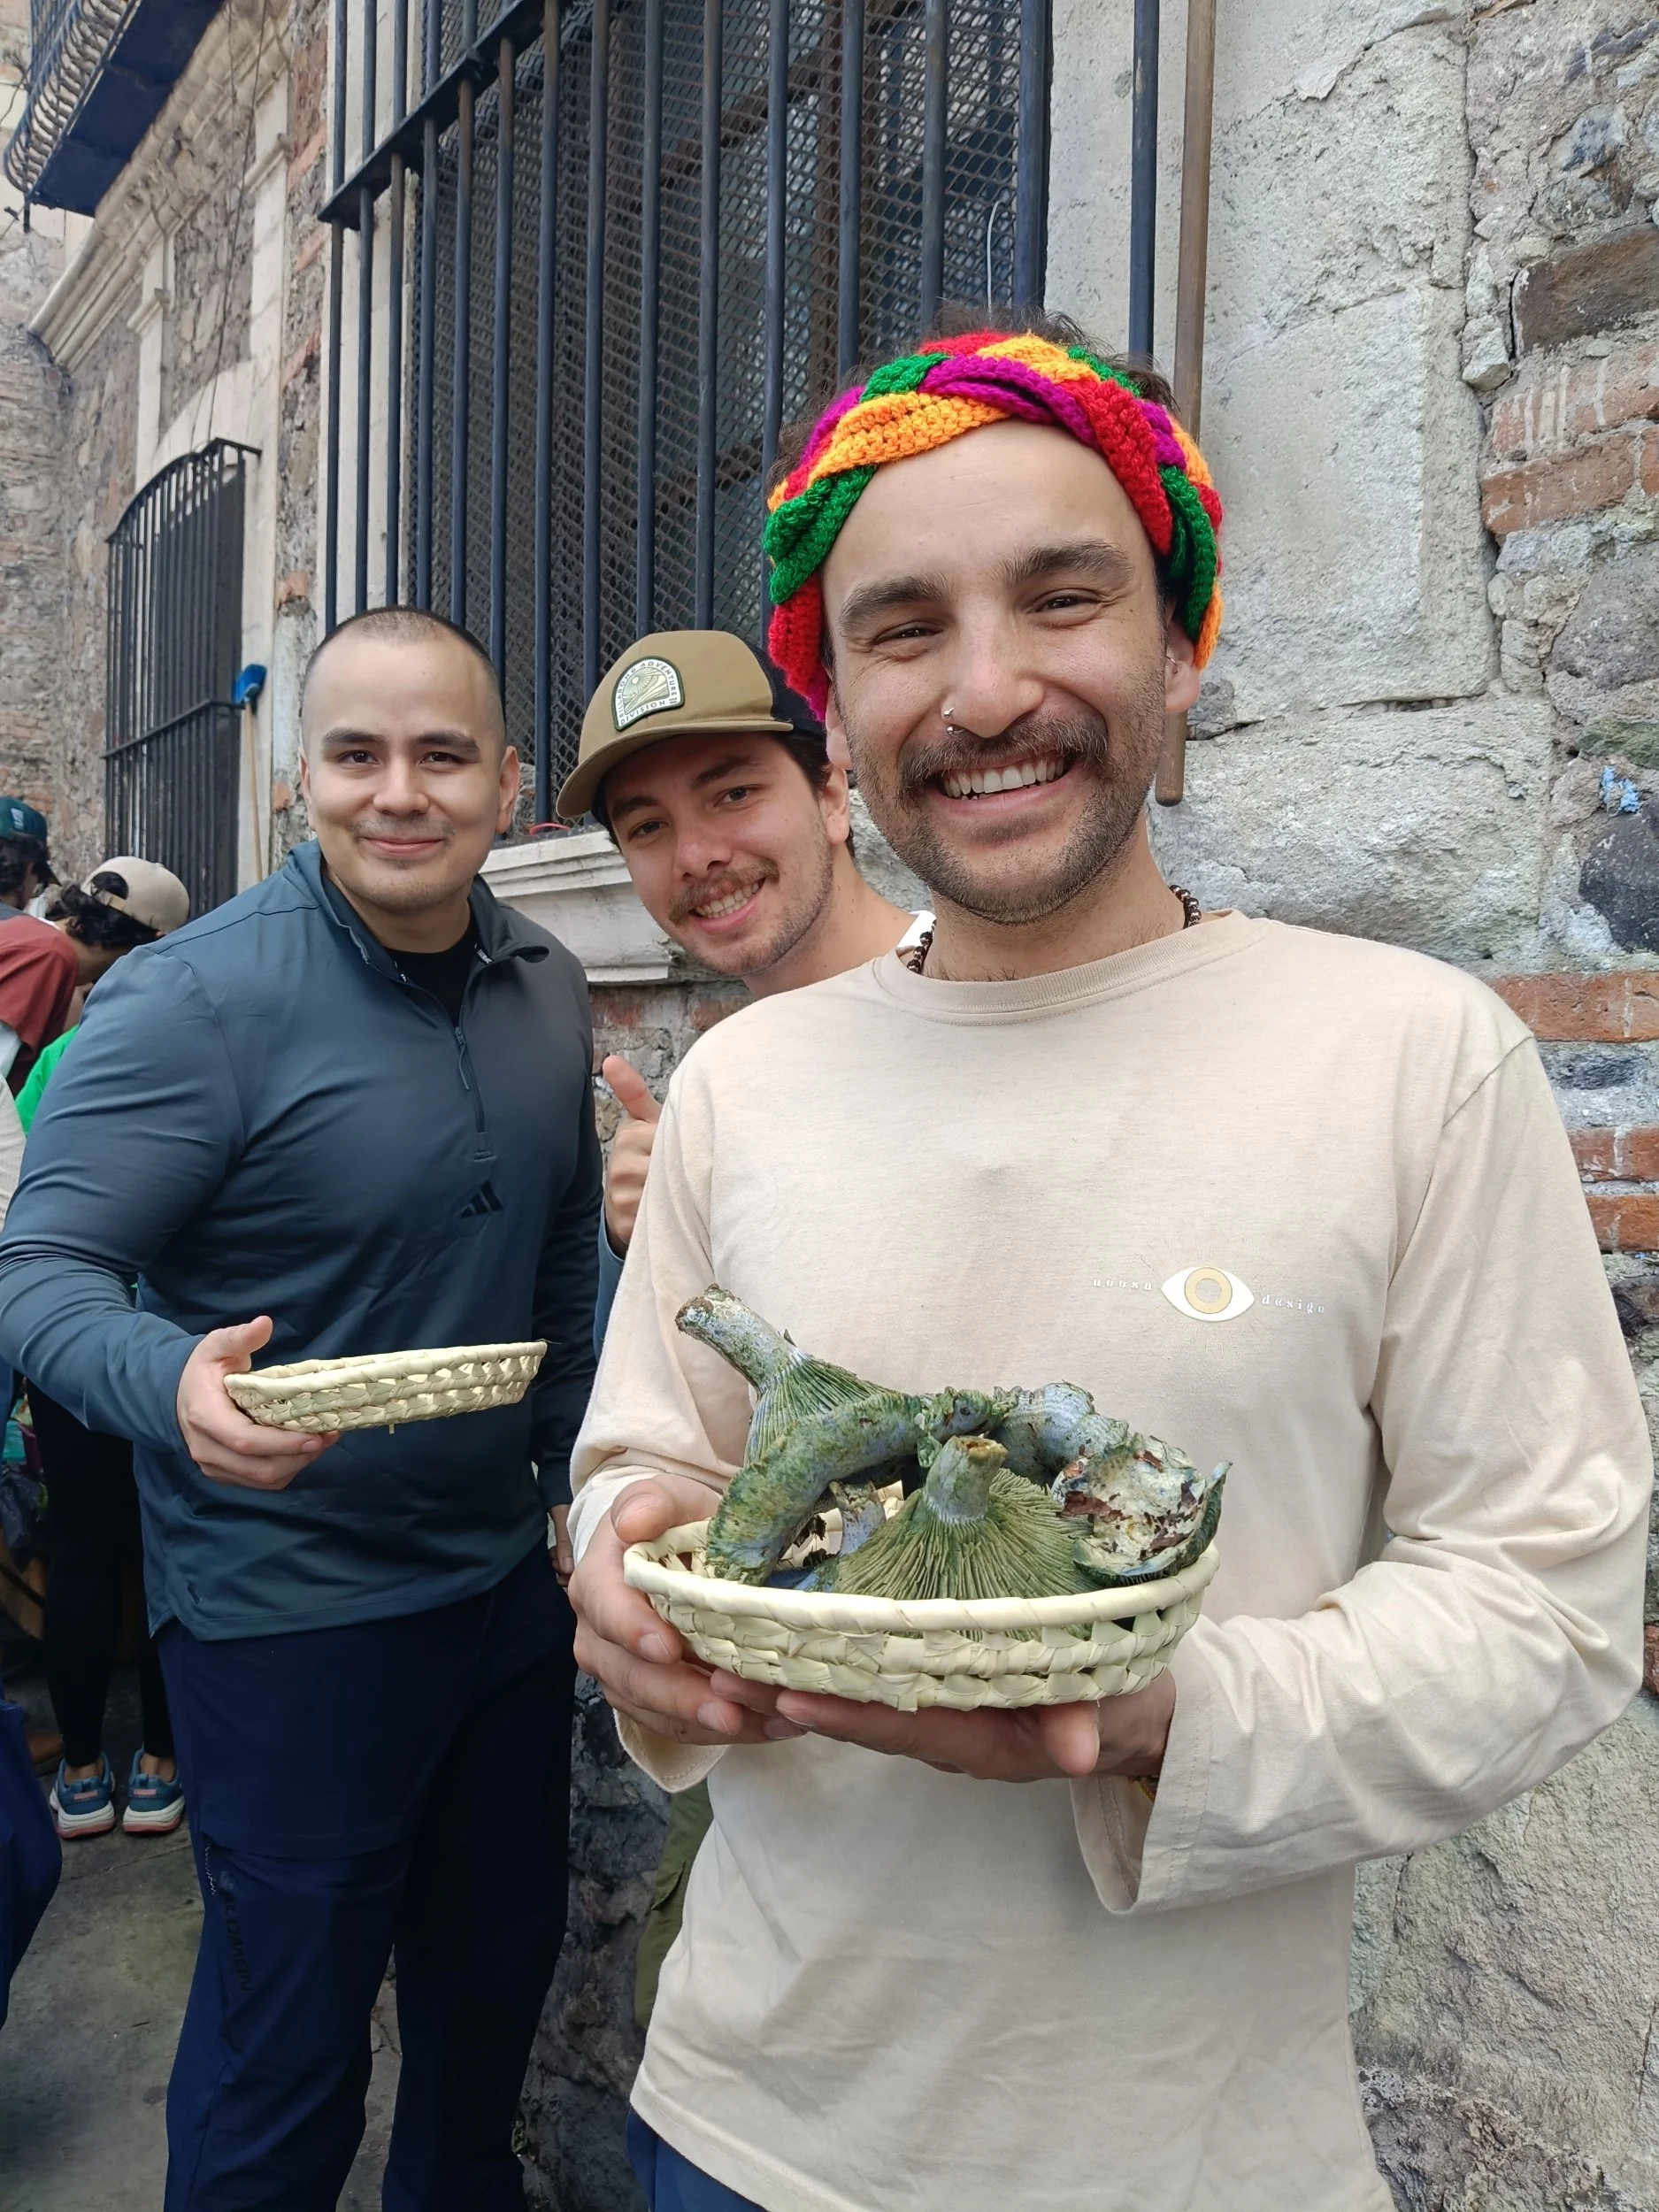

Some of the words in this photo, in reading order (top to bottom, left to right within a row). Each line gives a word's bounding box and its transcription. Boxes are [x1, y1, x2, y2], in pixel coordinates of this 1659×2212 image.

[617, 667, 636, 718] BILLABONG
[640, 661, 678, 696] ADVENTURE
[620, 700, 665, 725] DIVISION
[1261, 1294, 1325, 1315] design
